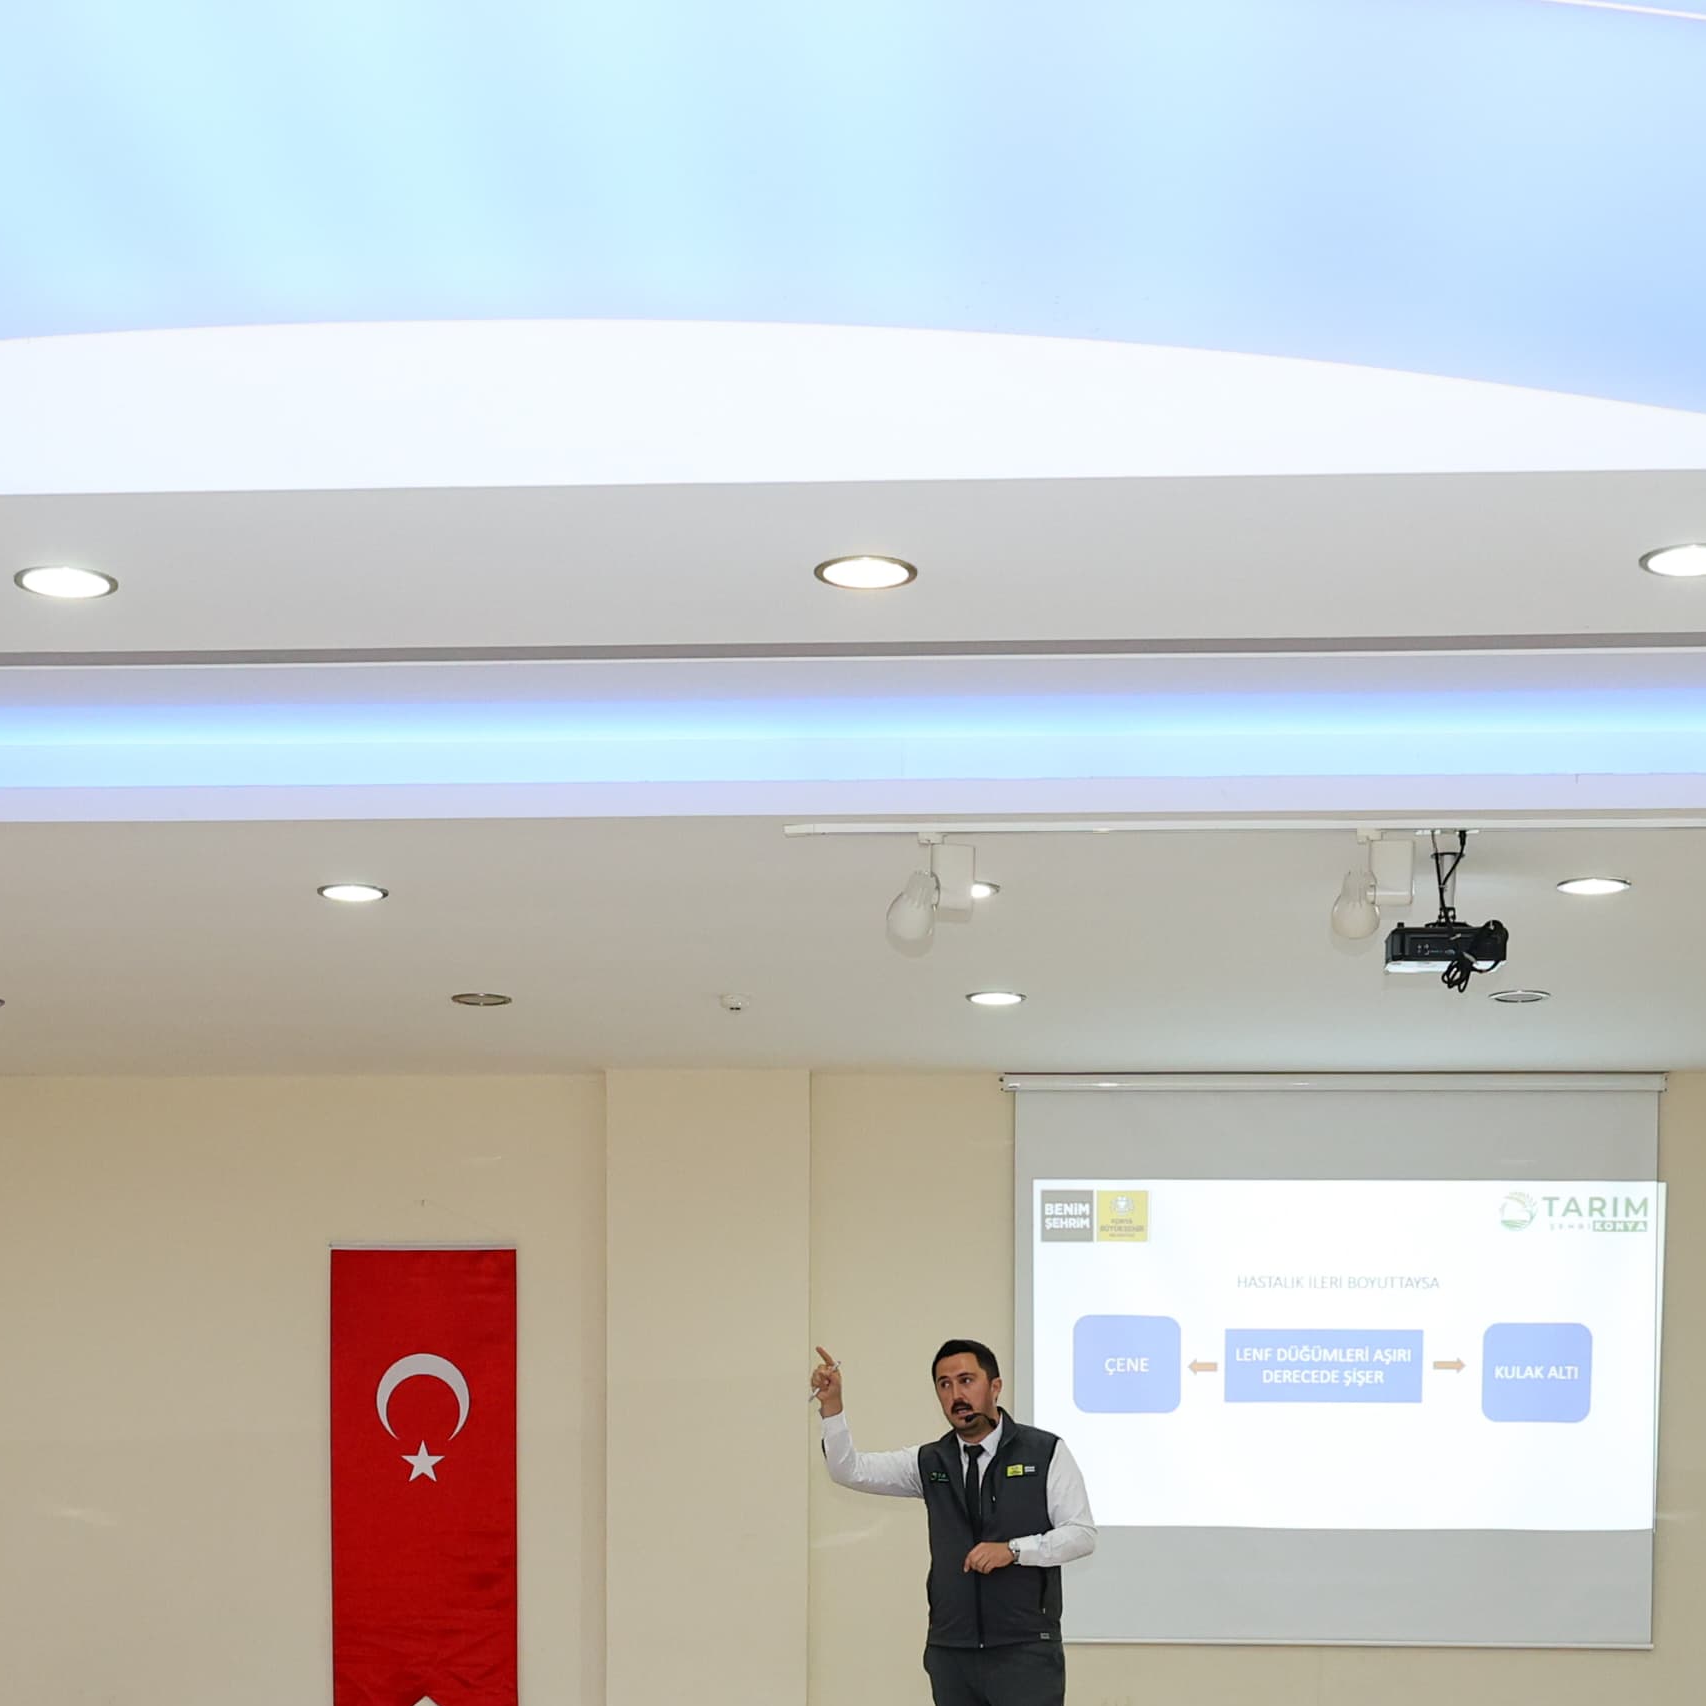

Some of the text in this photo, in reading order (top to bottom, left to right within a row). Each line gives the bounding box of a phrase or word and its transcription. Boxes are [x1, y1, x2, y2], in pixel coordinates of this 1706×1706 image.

[1542, 1196, 1649, 1218] TARIM
[1594, 1221, 1647, 1231] KONYA
[1235, 1345, 1412, 1365] LENF DÜĞÜMLERİ AŞIRI
[1104, 1357, 1150, 1376] ÇENE
[1494, 1365, 1580, 1380] KULAK ALTI
[1262, 1367, 1385, 1387] DERECEDE ŞİŞER
